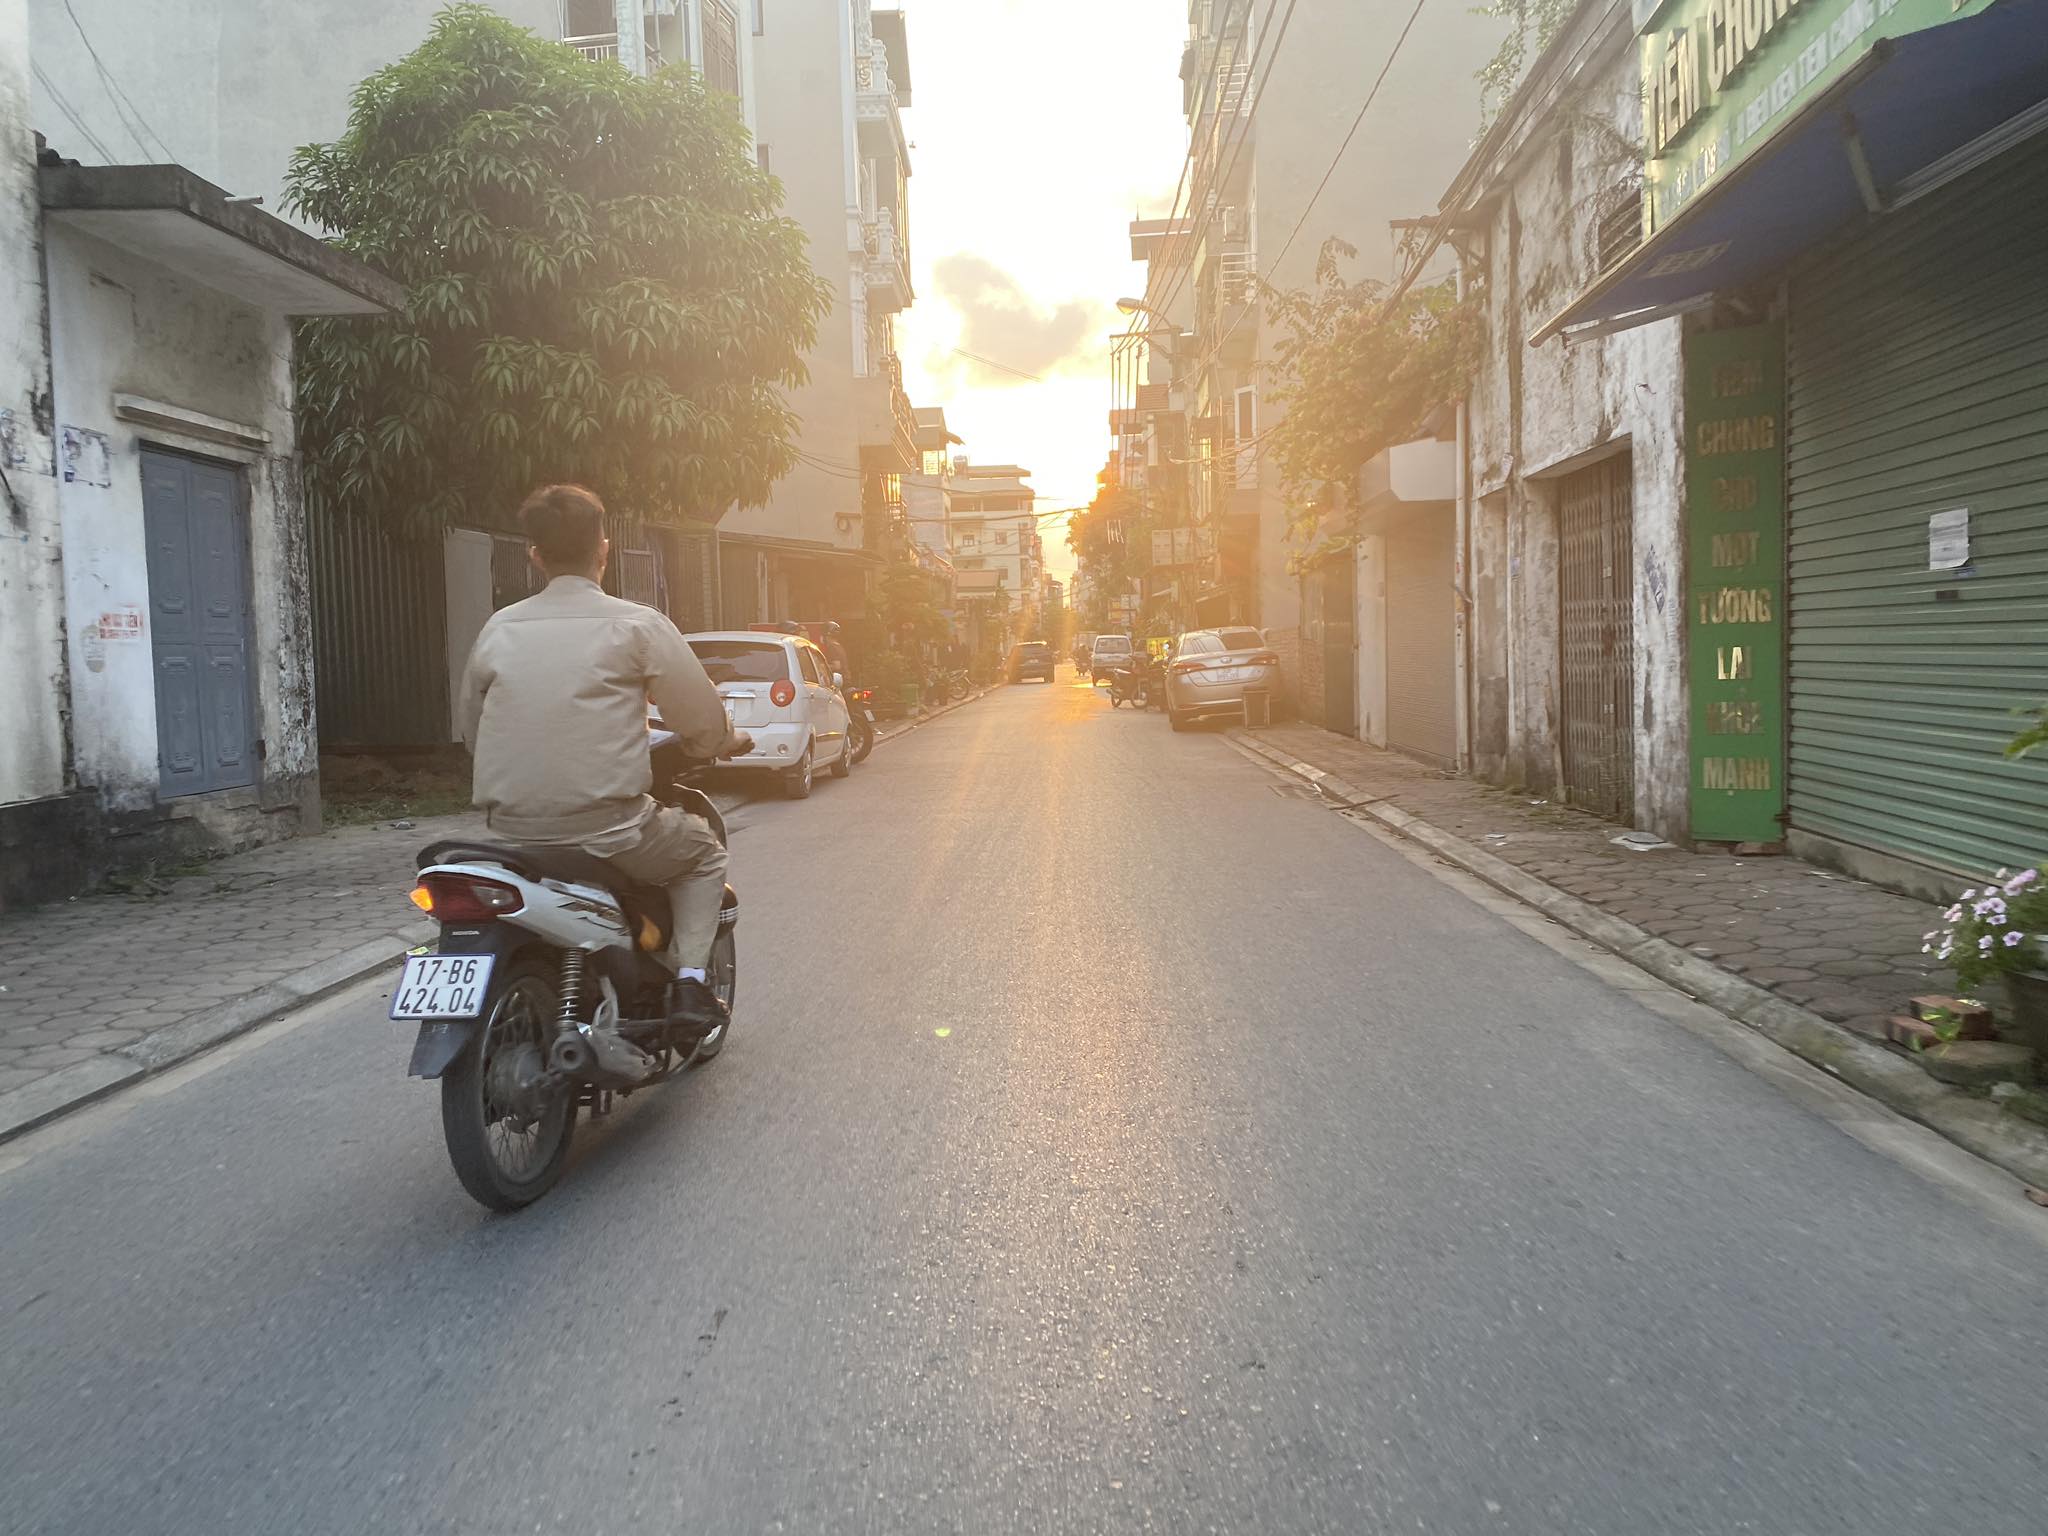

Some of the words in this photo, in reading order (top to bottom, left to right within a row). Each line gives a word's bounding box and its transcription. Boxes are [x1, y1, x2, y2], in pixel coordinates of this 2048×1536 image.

[1717, 646, 1752, 680] LAI
[1703, 757, 1770, 796] MẠNH
[416, 959, 478, 985] 17-B6
[398, 987, 475, 1014] 424.04
